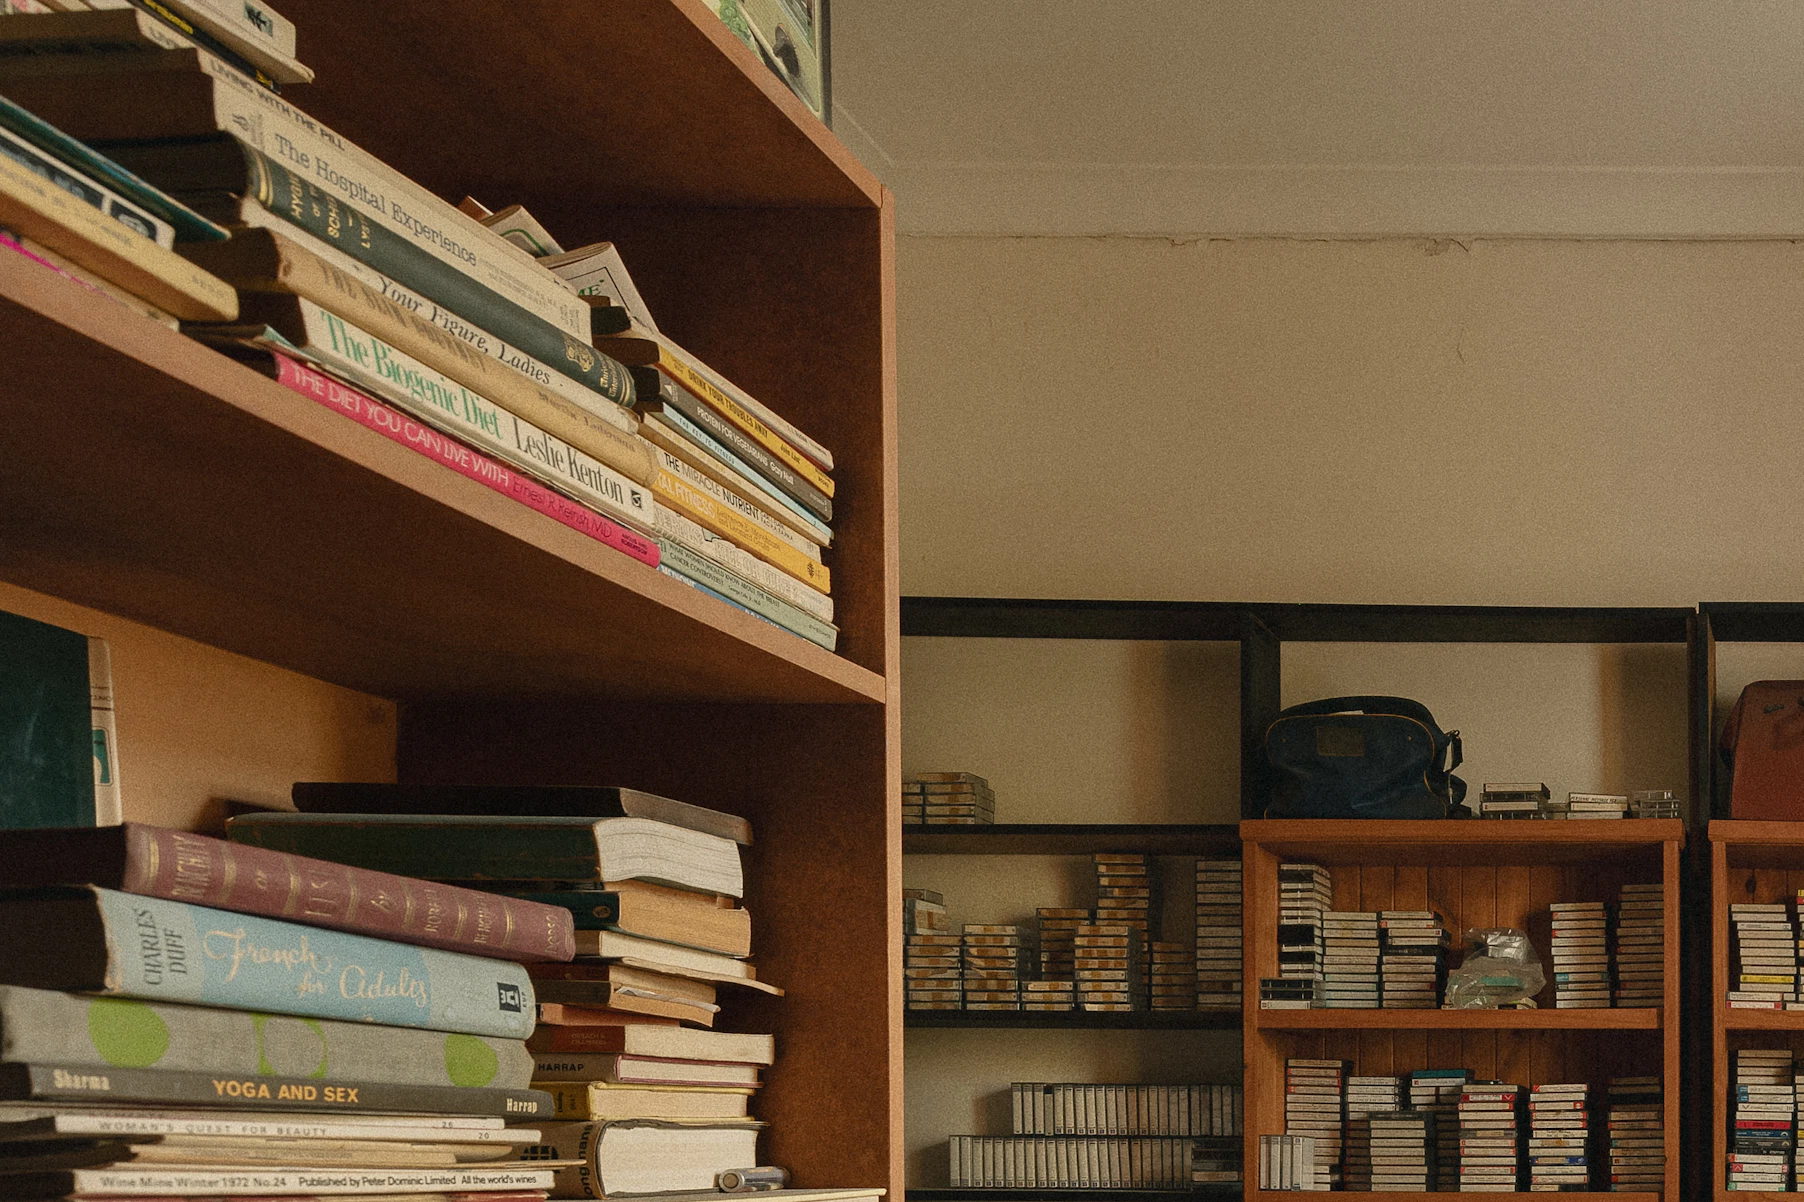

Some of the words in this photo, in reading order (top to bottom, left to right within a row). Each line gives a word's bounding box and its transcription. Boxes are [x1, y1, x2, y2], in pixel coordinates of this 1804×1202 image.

[210, 60, 254, 96] LIVING
[256, 88, 290, 117] WITH
[292, 111, 317, 134] THE
[319, 129, 345, 152] PILL
[274, 132, 310, 170] The
[315, 156, 387, 216] Hospital
[390, 200, 478, 268] Experience
[378, 275, 423, 315] Your
[429, 305, 491, 355] Figure,
[497, 339, 552, 386] Ladies
[318, 308, 370, 369] The
[373, 341, 460, 424] Biogenic
[459, 387, 504, 441] Diet
[512, 414, 565, 472] Leslie
[567, 440, 624, 505] Kenton
[687, 369, 709, 392] DRINK
[708, 384, 725, 405] YOUR
[723, 395, 754, 428] TROUBLES
[292, 363, 326, 395] THE
[326, 377, 362, 415] DIET
[363, 399, 401, 434] YOU
[403, 421, 442, 453] CAN
[443, 438, 470, 469] LIVE
[471, 452, 510, 487] WITH
[589, 516, 614, 539] MD
[678, 416, 690, 430] THE
[691, 426, 704, 440] KEY
[704, 435, 713, 448] TO
[714, 443, 736, 466] FITNESS
[696, 405, 722, 433] PROTEIN
[720, 423, 734, 440] FOR
[732, 431, 769, 467] VEGETARIANS
[769, 460, 784, 479] Gary
[663, 450, 681, 473] THE
[681, 461, 721, 496] MIRACLE
[721, 485, 760, 522] NUTRIENT
[675, 483, 718, 519] FITNESS
[669, 552, 690, 570] CANCER
[132, 905, 164, 988] CHARLES
[167, 928, 190, 977] DUFF
[201, 927, 334, 985] French
[338, 963, 429, 1009] Adults
[53, 1068, 111, 1092] Sharma
[211, 1078, 271, 1100] YOGA
[277, 1084, 318, 1102] AND
[323, 1085, 361, 1104] SEX
[537, 1062, 585, 1073] HARRAP
[99, 1121, 174, 1133] WOMAN'S
[185, 1123, 232, 1136] QUEST
[241, 1124, 268, 1136] FOR
[276, 1125, 328, 1138] BEAUTY
[441, 1120, 454, 1130] 26
[505, 1097, 539, 1115] Harrap
[477, 1131, 491, 1141] 20
[577, 1123, 594, 1197] ongmans
[175, 1176, 221, 1189] Winter
[222, 1175, 250, 1188] 1972
[298, 1175, 348, 1188] Published
[349, 1175, 361, 1189] by
[361, 1175, 388, 1188] Peter
[387, 1174, 424, 1187] Dominic
[423, 1174, 457, 1187] Limited
[461, 1174, 472, 1186] All
[472, 1174, 487, 1186] the
[486, 1174, 515, 1186] world's
[515, 1175, 538, 1185] wines
